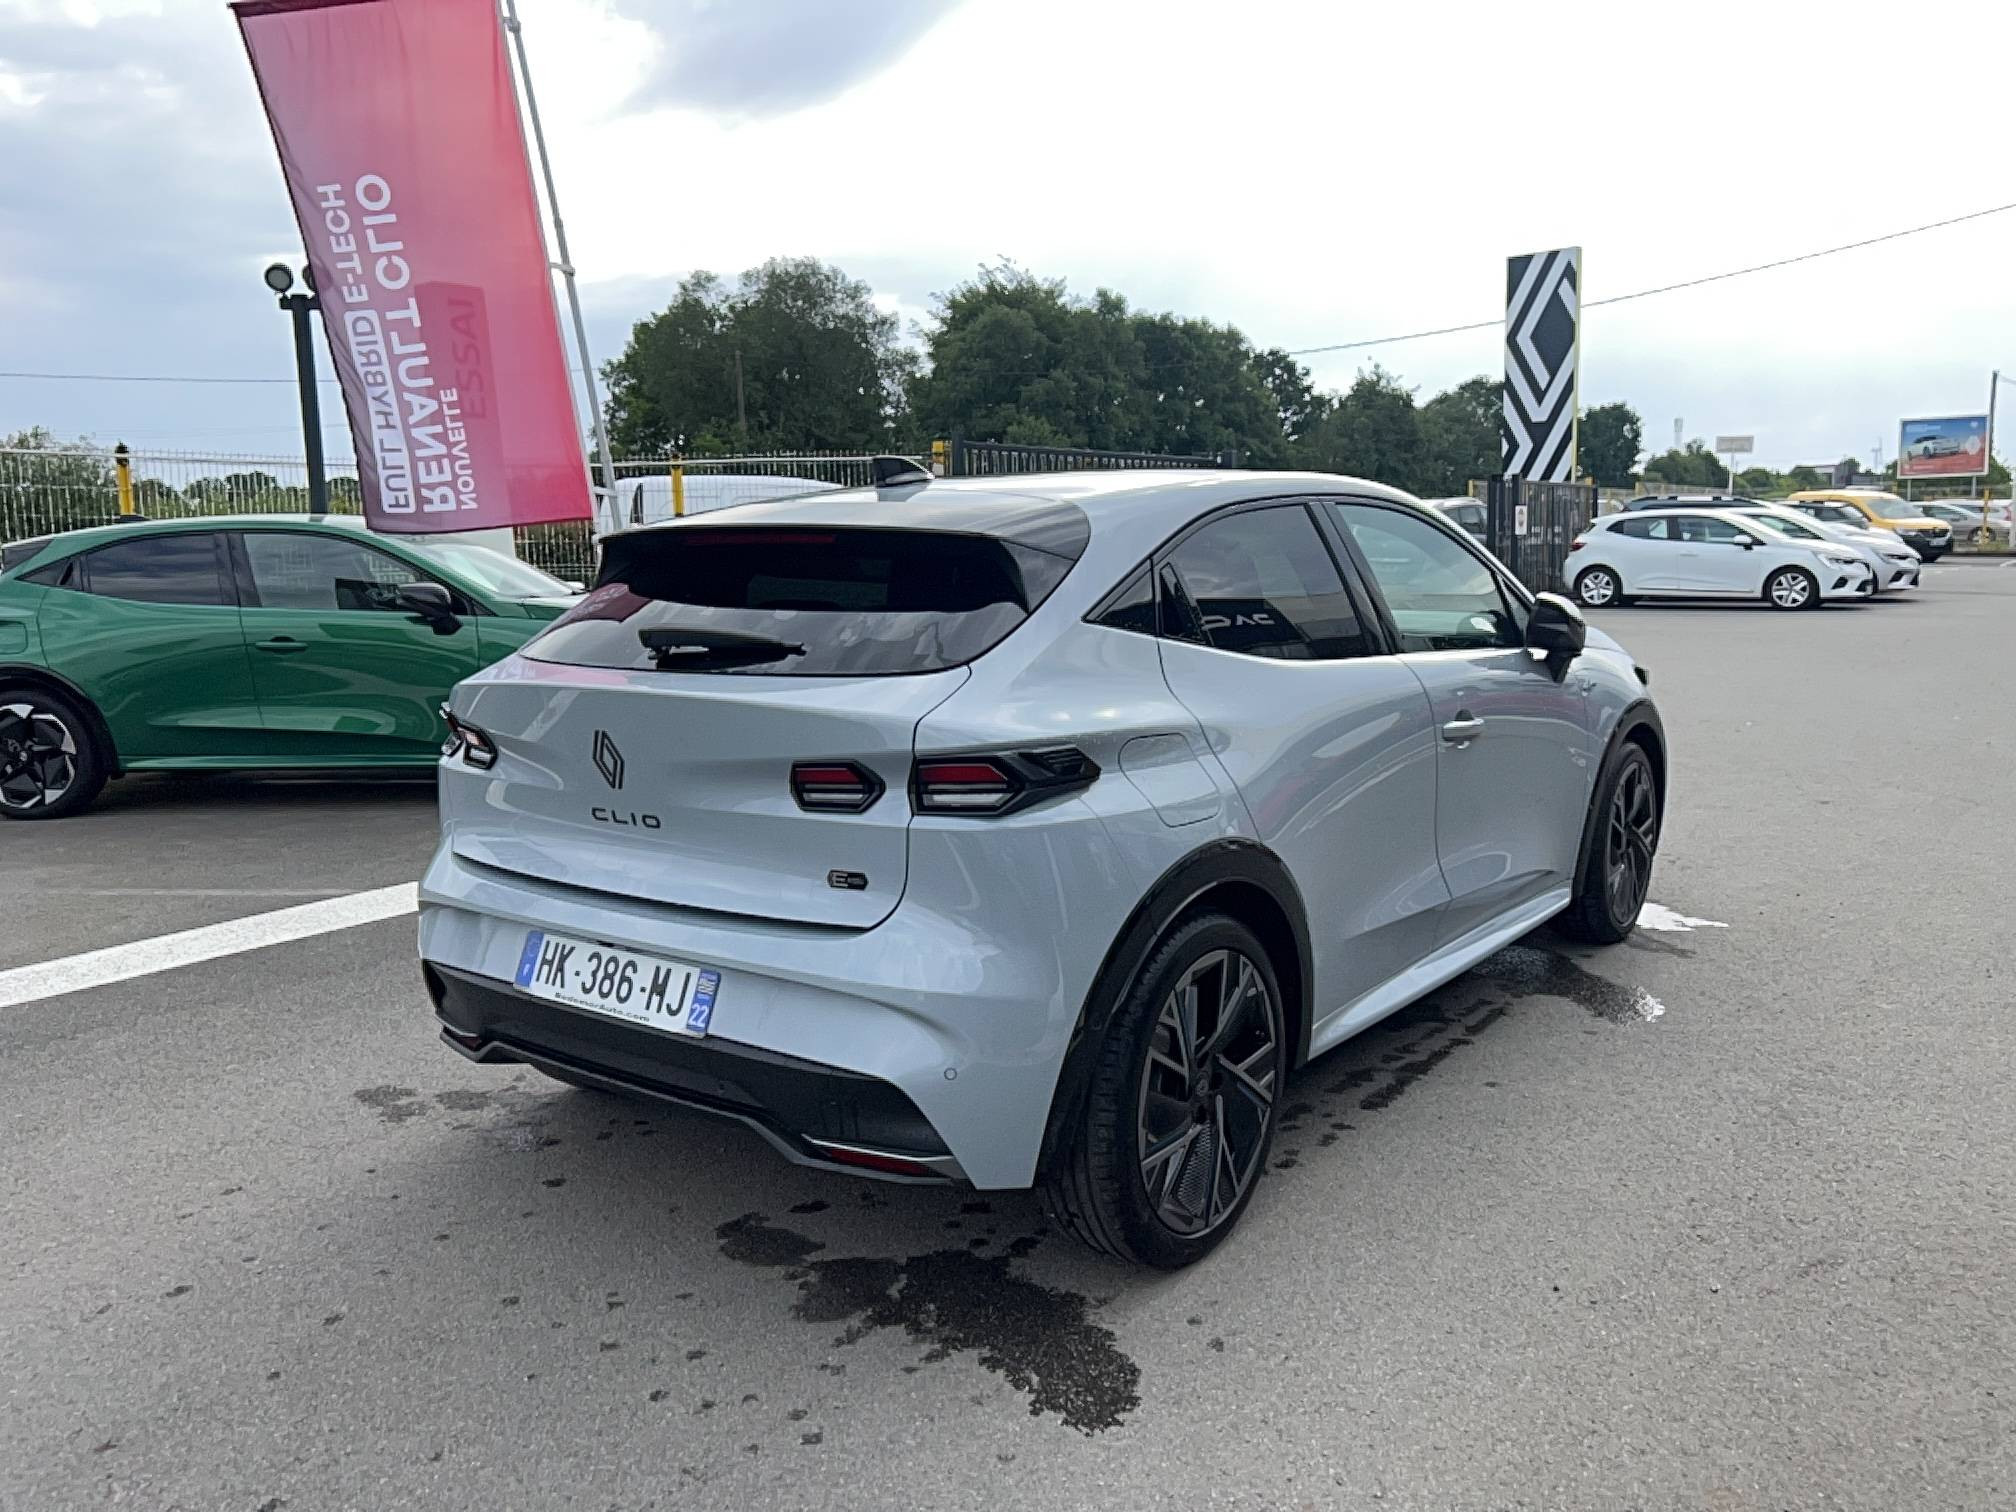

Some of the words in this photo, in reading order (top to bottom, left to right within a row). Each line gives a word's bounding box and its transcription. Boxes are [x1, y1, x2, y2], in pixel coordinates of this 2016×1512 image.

[447, 298, 486, 419] ESSAI
[591, 807, 662, 829] CLIO
[536, 940, 691, 1017] HK-386-MJ
[689, 1003, 710, 1027] 22
